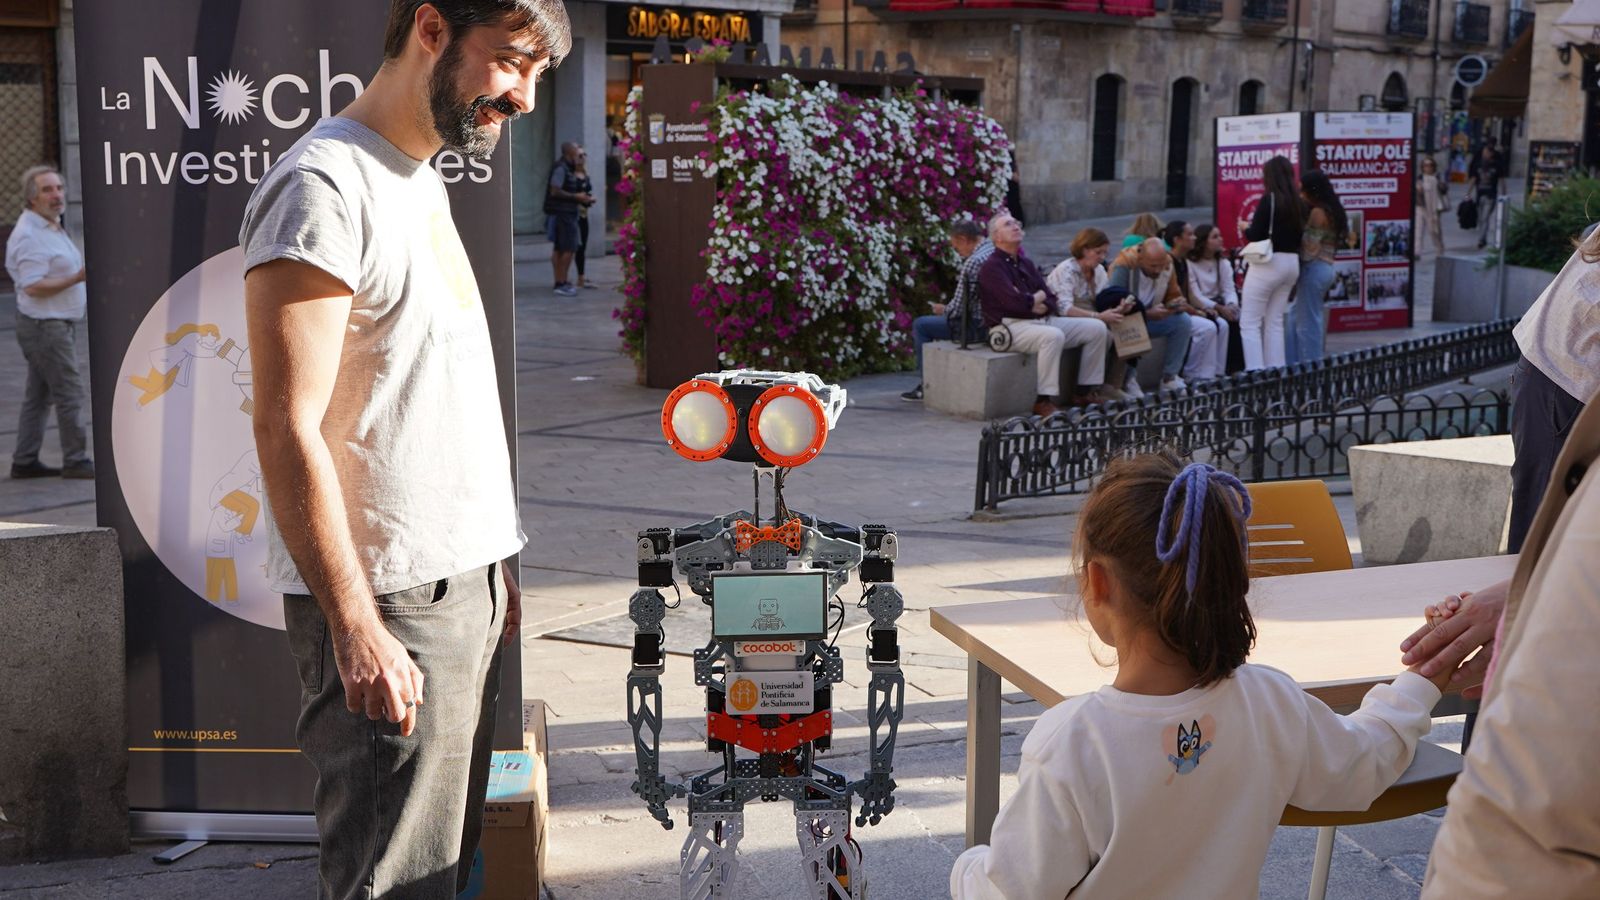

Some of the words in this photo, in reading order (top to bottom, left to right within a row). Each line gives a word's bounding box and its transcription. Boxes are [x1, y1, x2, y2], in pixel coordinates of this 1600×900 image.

[626, 7, 680, 39] SABOR
[101, 86, 131, 111] La
[1316, 145, 1380, 160] STARTUP
[1385, 140, 1411, 159] OLÉ
[1221, 168, 1264, 181] SALAMAN
[743, 642, 796, 653] cocobot
[761, 682, 804, 690] Universidad
[761, 691, 795, 699] Pontificia
[771, 699, 810, 707] Salamanca
[153, 730, 237, 742] www.upsa.es
